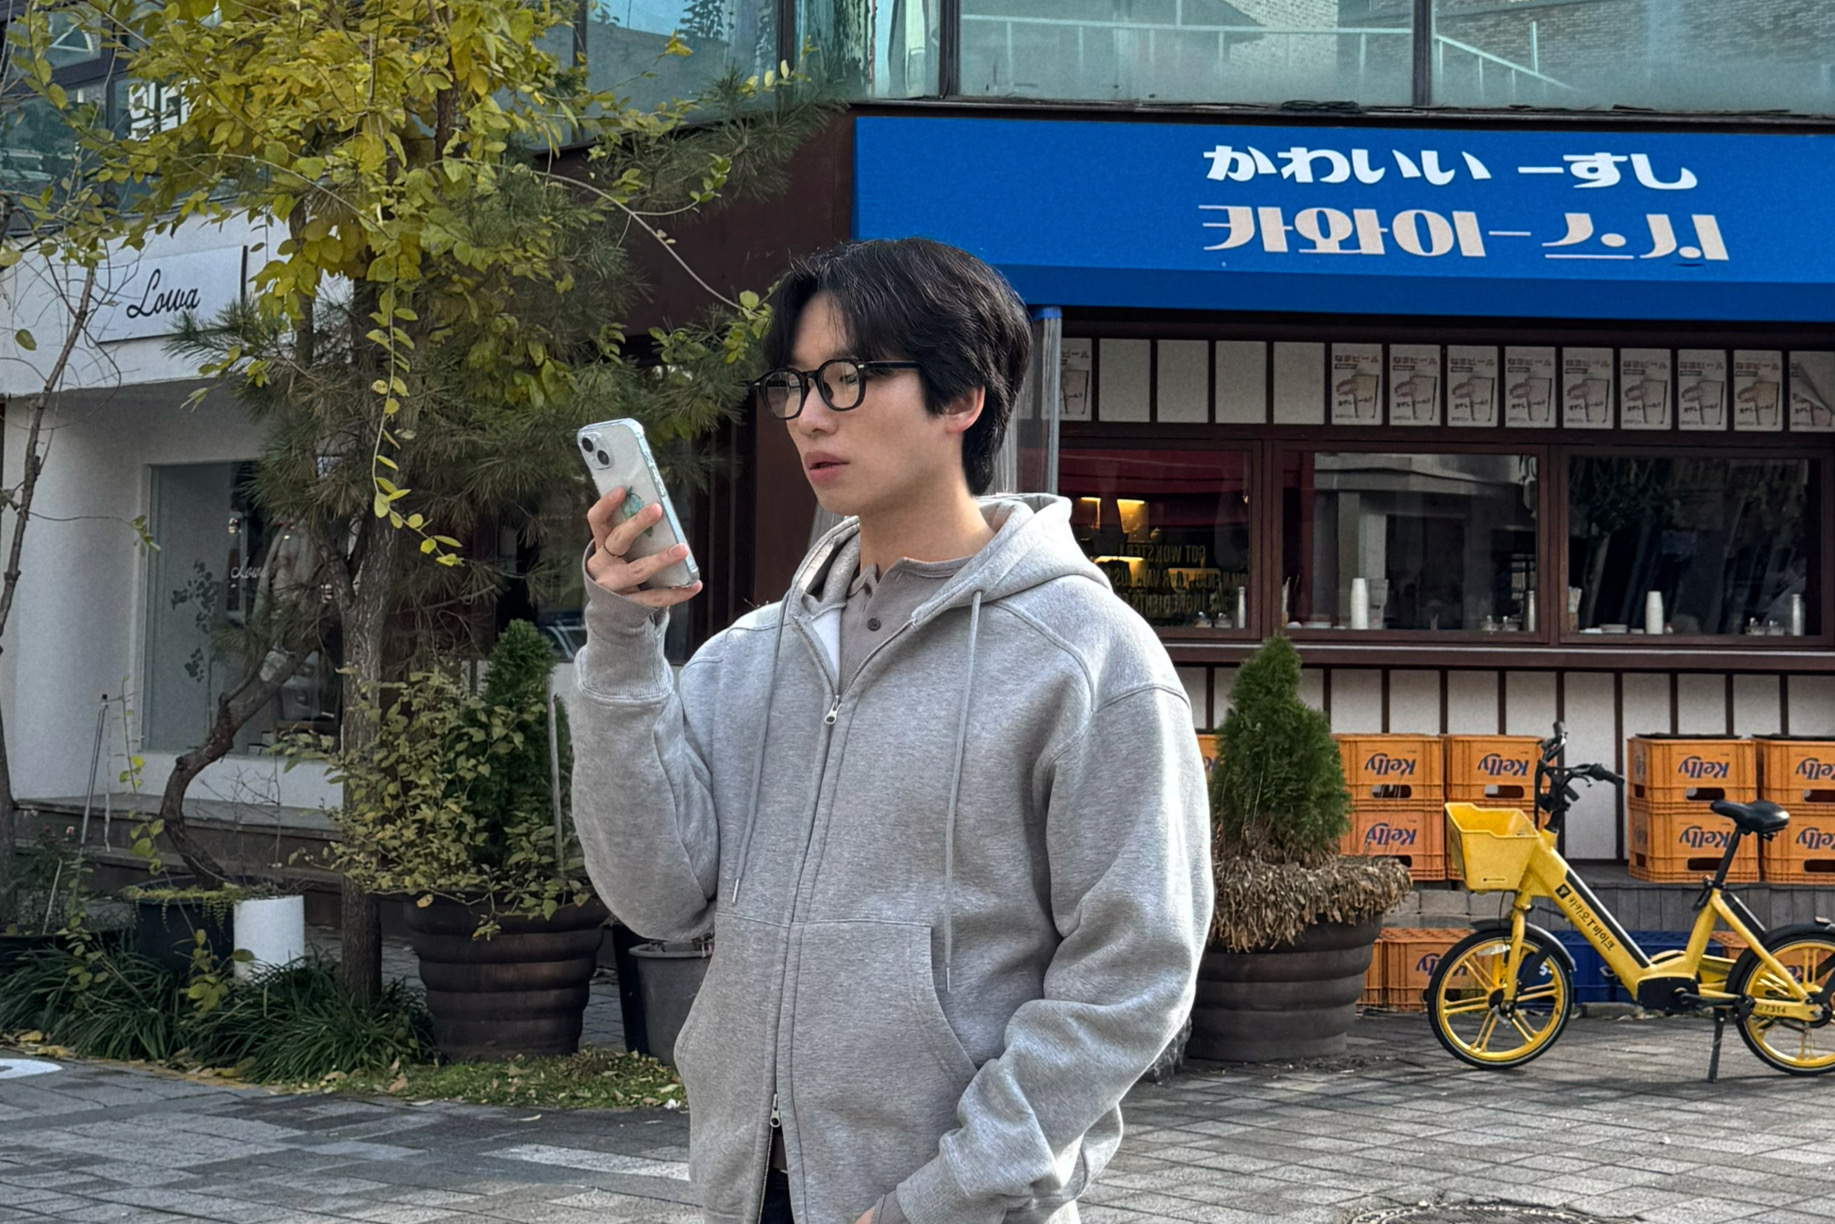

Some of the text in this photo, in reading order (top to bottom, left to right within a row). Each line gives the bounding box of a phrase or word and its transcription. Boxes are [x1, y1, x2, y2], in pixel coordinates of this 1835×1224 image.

[1203, 145, 1492, 186] かわいい
[126, 268, 201, 319] Lowa
[1364, 753, 1416, 776] Kelly
[1478, 753, 1529, 776] Kelly
[1678, 755, 1730, 779] Kelly
[1795, 757, 1835, 780] elly
[1365, 822, 1417, 846] Kelly
[1795, 827, 1835, 850] elly
